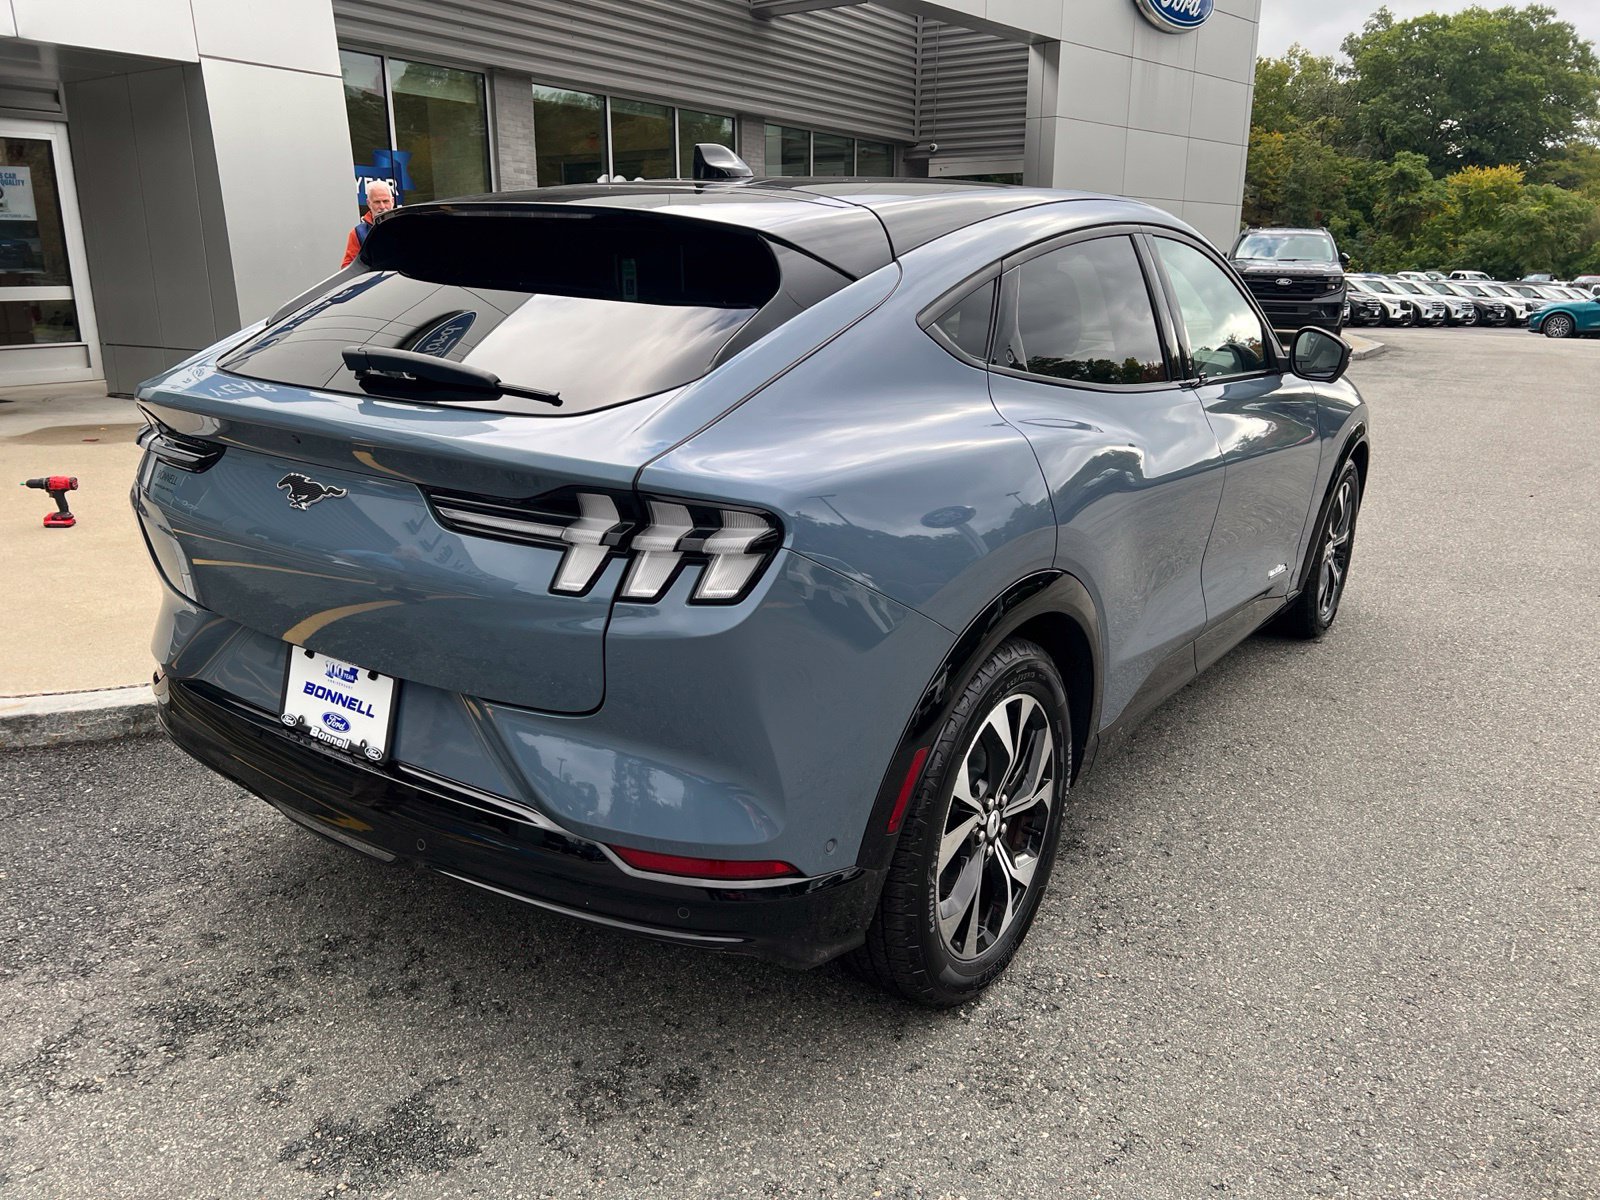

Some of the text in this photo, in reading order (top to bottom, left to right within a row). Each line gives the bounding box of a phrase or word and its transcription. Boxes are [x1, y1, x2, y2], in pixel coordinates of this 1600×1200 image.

[2, 179, 24, 187] QUALITY
[356, 176, 399, 195] YER
[325, 660, 344, 679] 100
[303, 681, 375, 719] BONNELL
[325, 713, 347, 731] Ford
[309, 726, 351, 749] Bonnell
